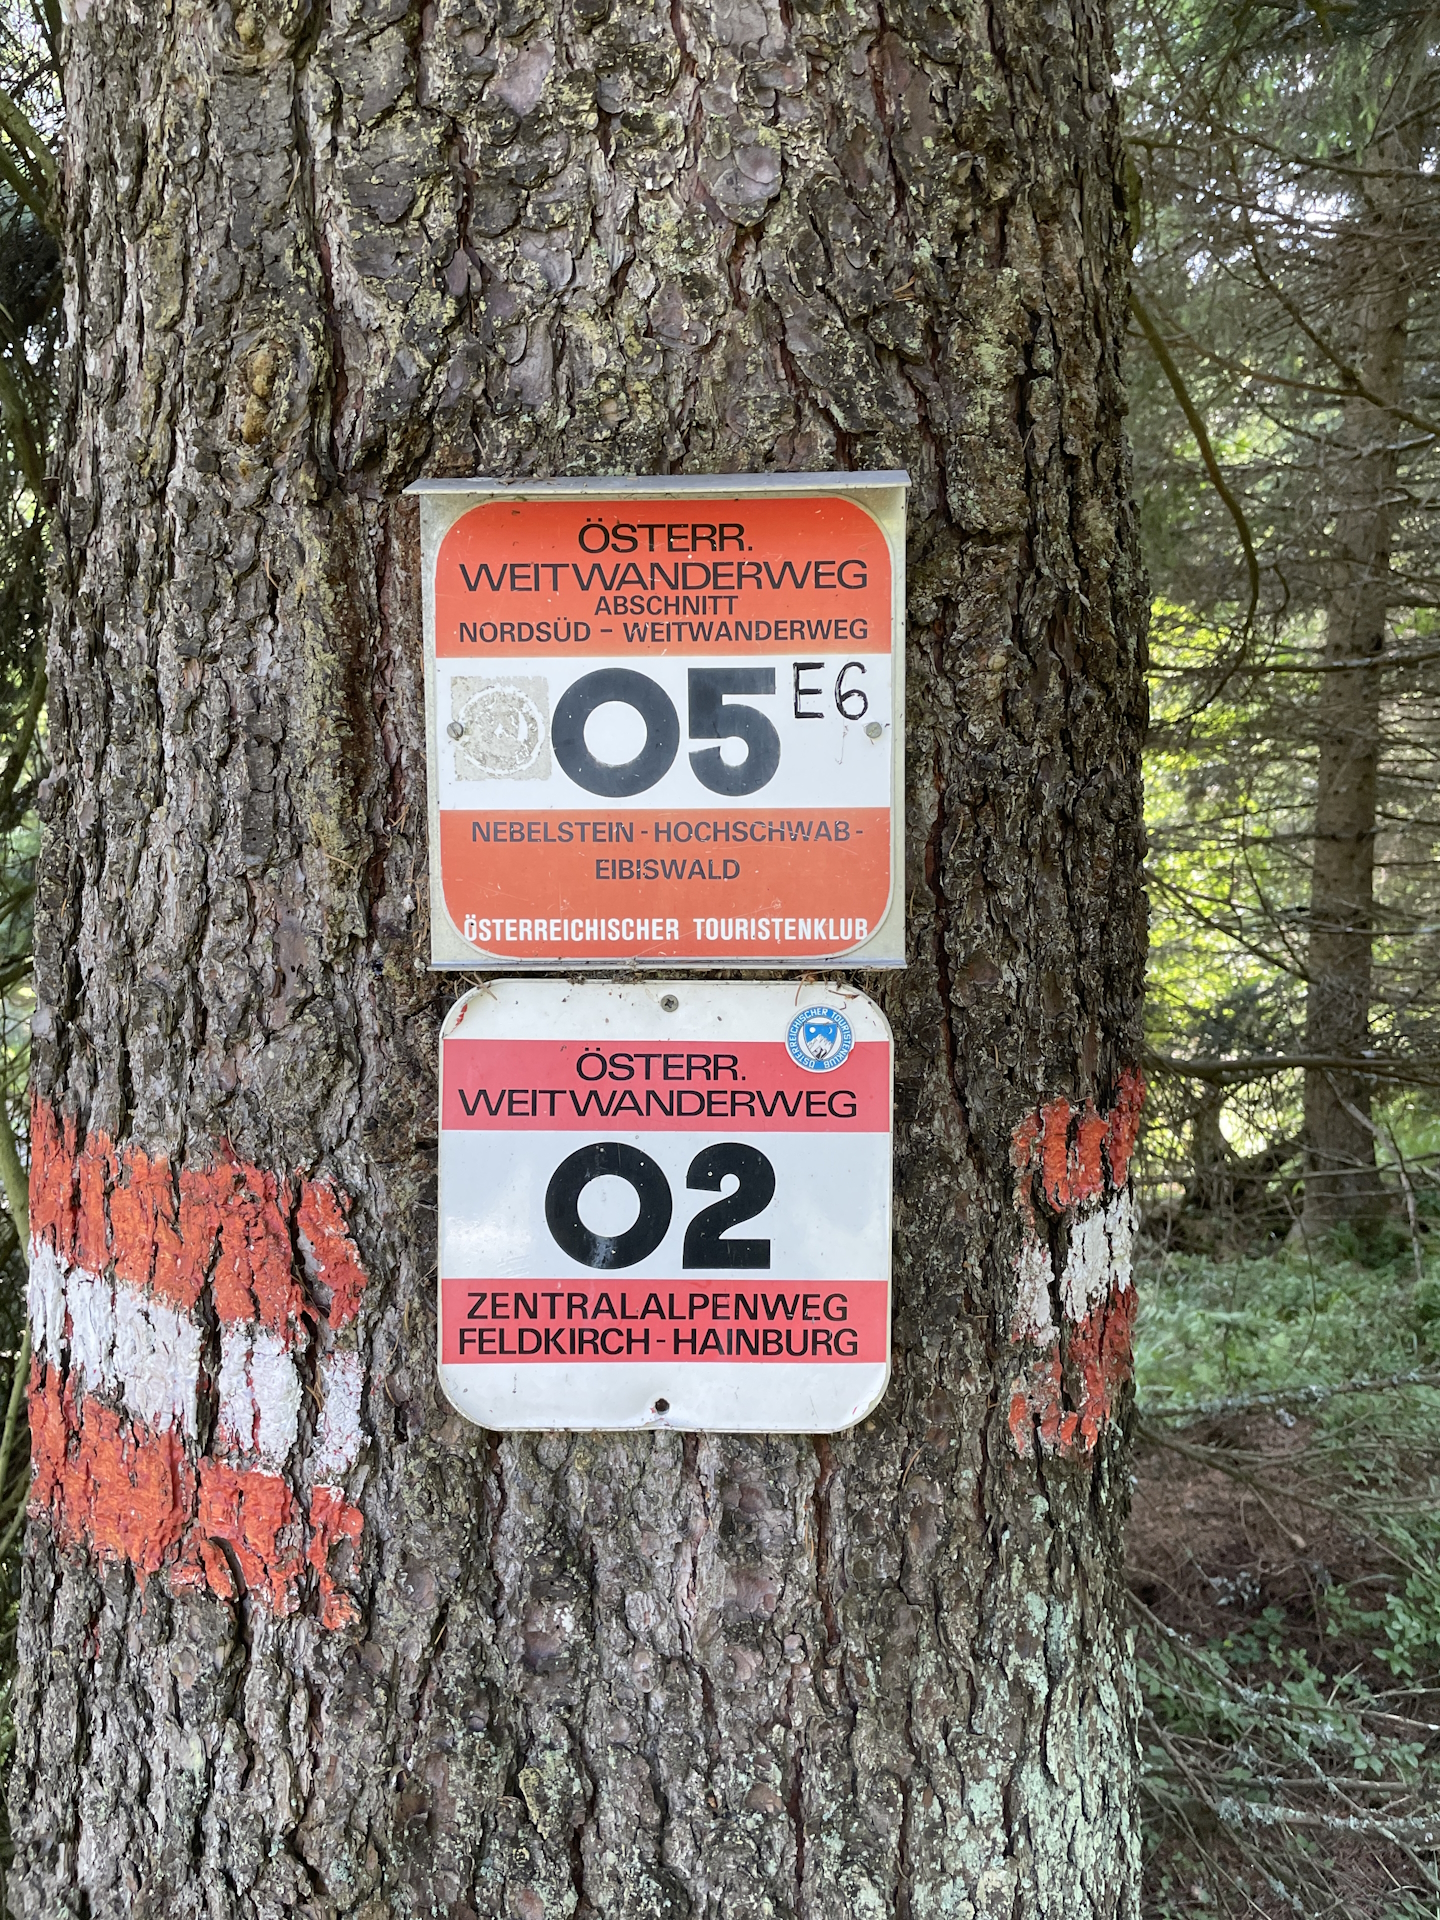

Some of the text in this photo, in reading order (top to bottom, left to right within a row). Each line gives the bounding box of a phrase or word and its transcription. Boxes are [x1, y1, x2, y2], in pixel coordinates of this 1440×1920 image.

[579, 518, 753, 553] ÖSTERR.
[459, 560, 868, 591] WEITWANDERWEG
[594, 595, 739, 616] ABSCHNITT
[459, 617, 591, 642] NORDSÜD
[623, 619, 868, 642] WEITWANDERWEG
[551, 668, 782, 798] 05
[595, 859, 741, 881] EIBISWALD
[464, 914, 869, 943] ÖSTERREICHISCHER TOURISTENKLUB
[576, 1047, 746, 1081] ÖSTERR.
[458, 1089, 858, 1118] WEITWANDERWEG
[545, 1142, 776, 1270] 02
[467, 1292, 848, 1321] ZENTRALALPENWEG
